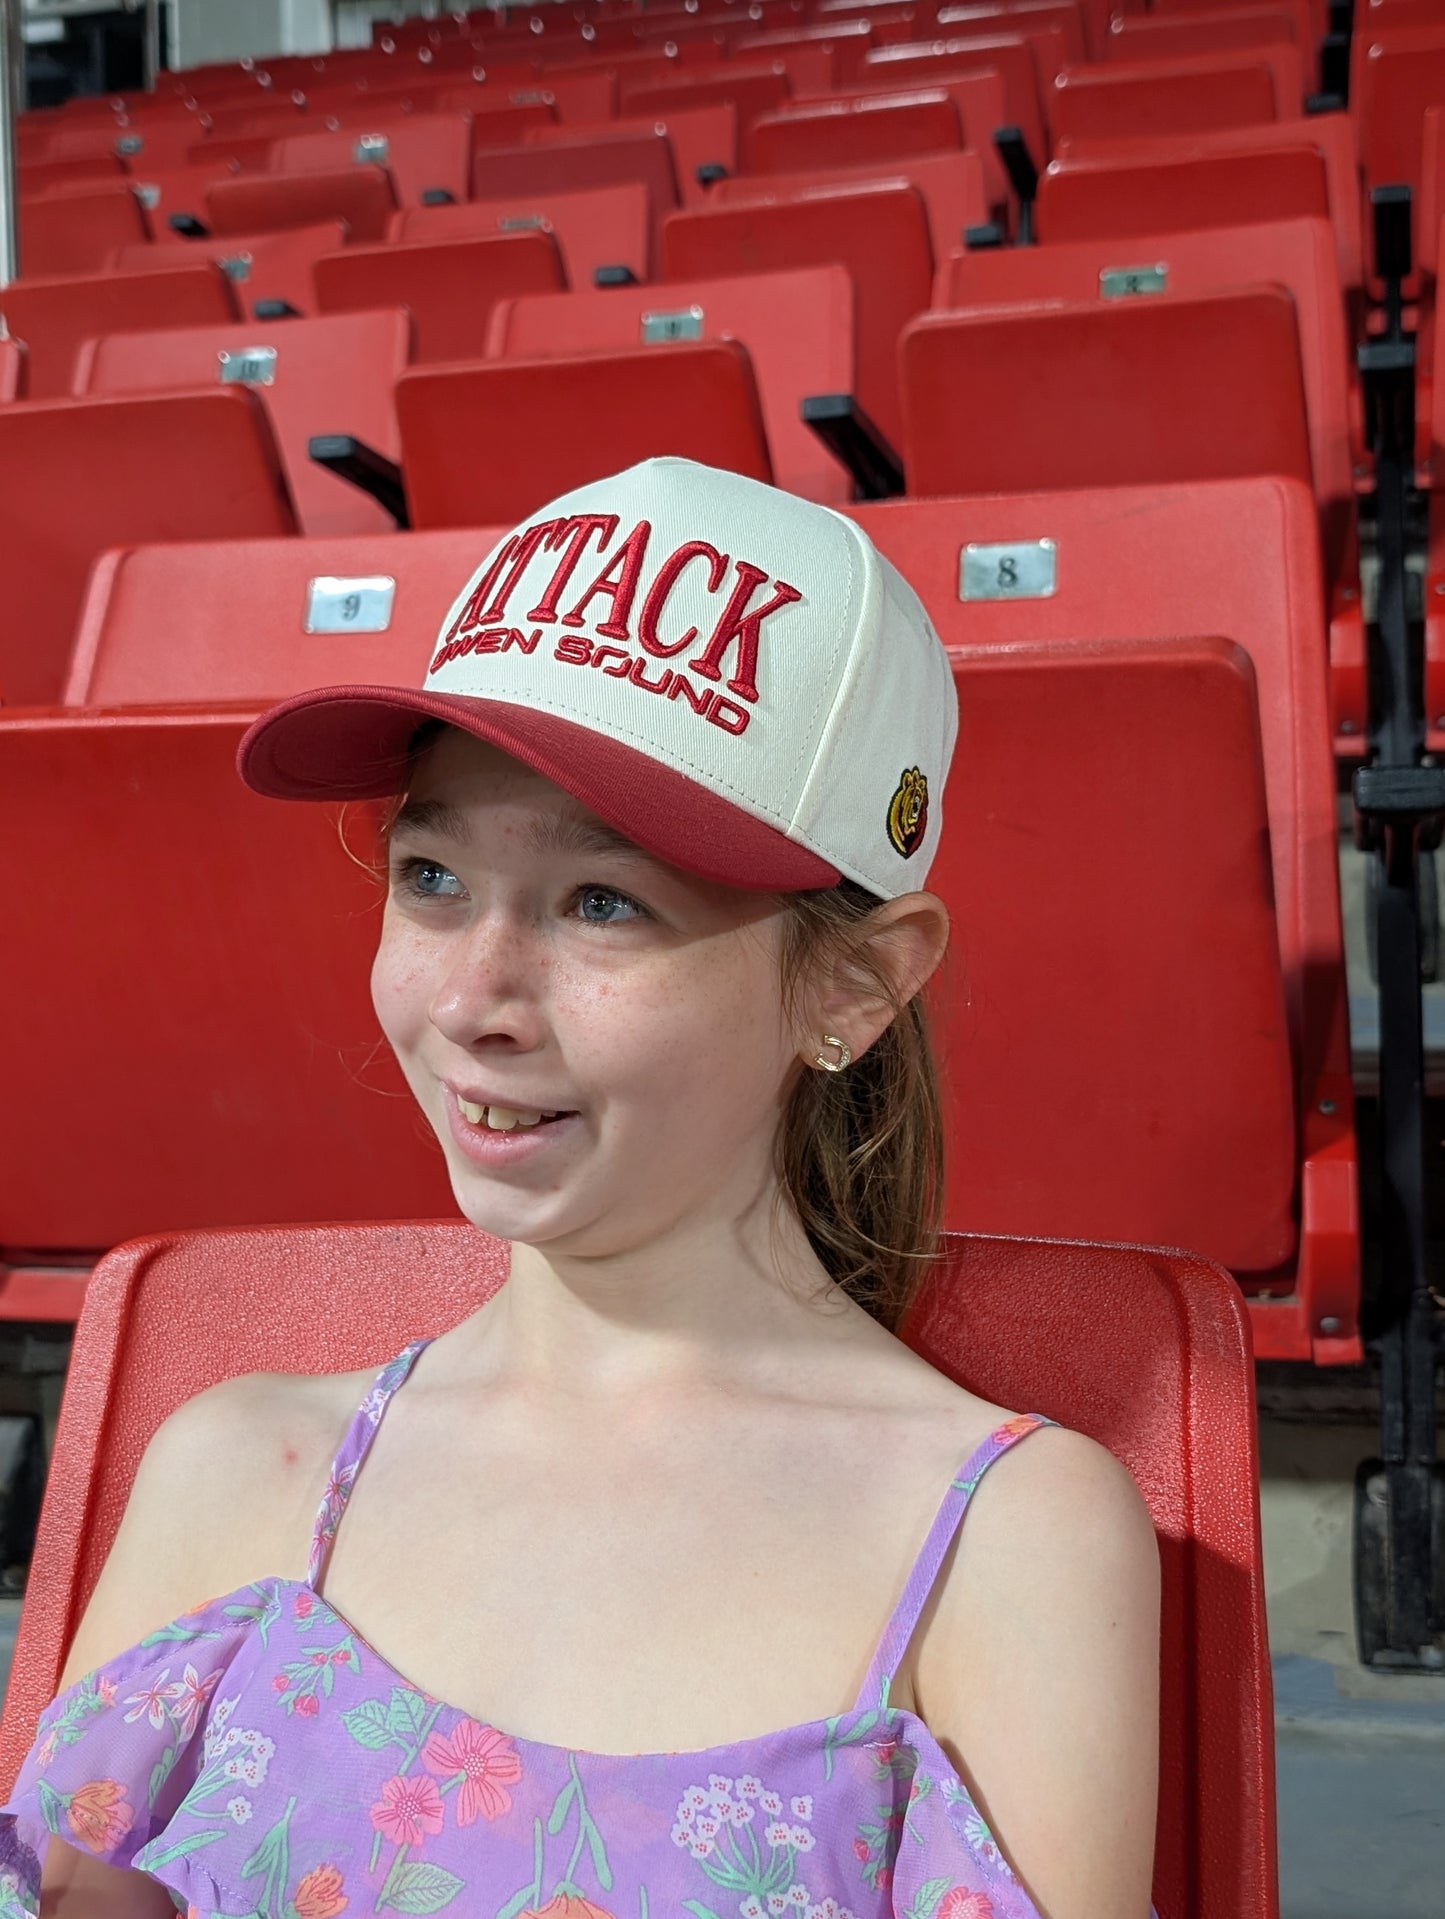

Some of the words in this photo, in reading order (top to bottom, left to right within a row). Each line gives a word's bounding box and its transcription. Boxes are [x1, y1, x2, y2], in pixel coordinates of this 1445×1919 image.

[997, 555, 1019, 588] 8
[342, 593, 361, 622] 9
[445, 513, 802, 704] ATTACK
[429, 627, 543, 675] OWEN
[553, 634, 750, 736] SOUND
